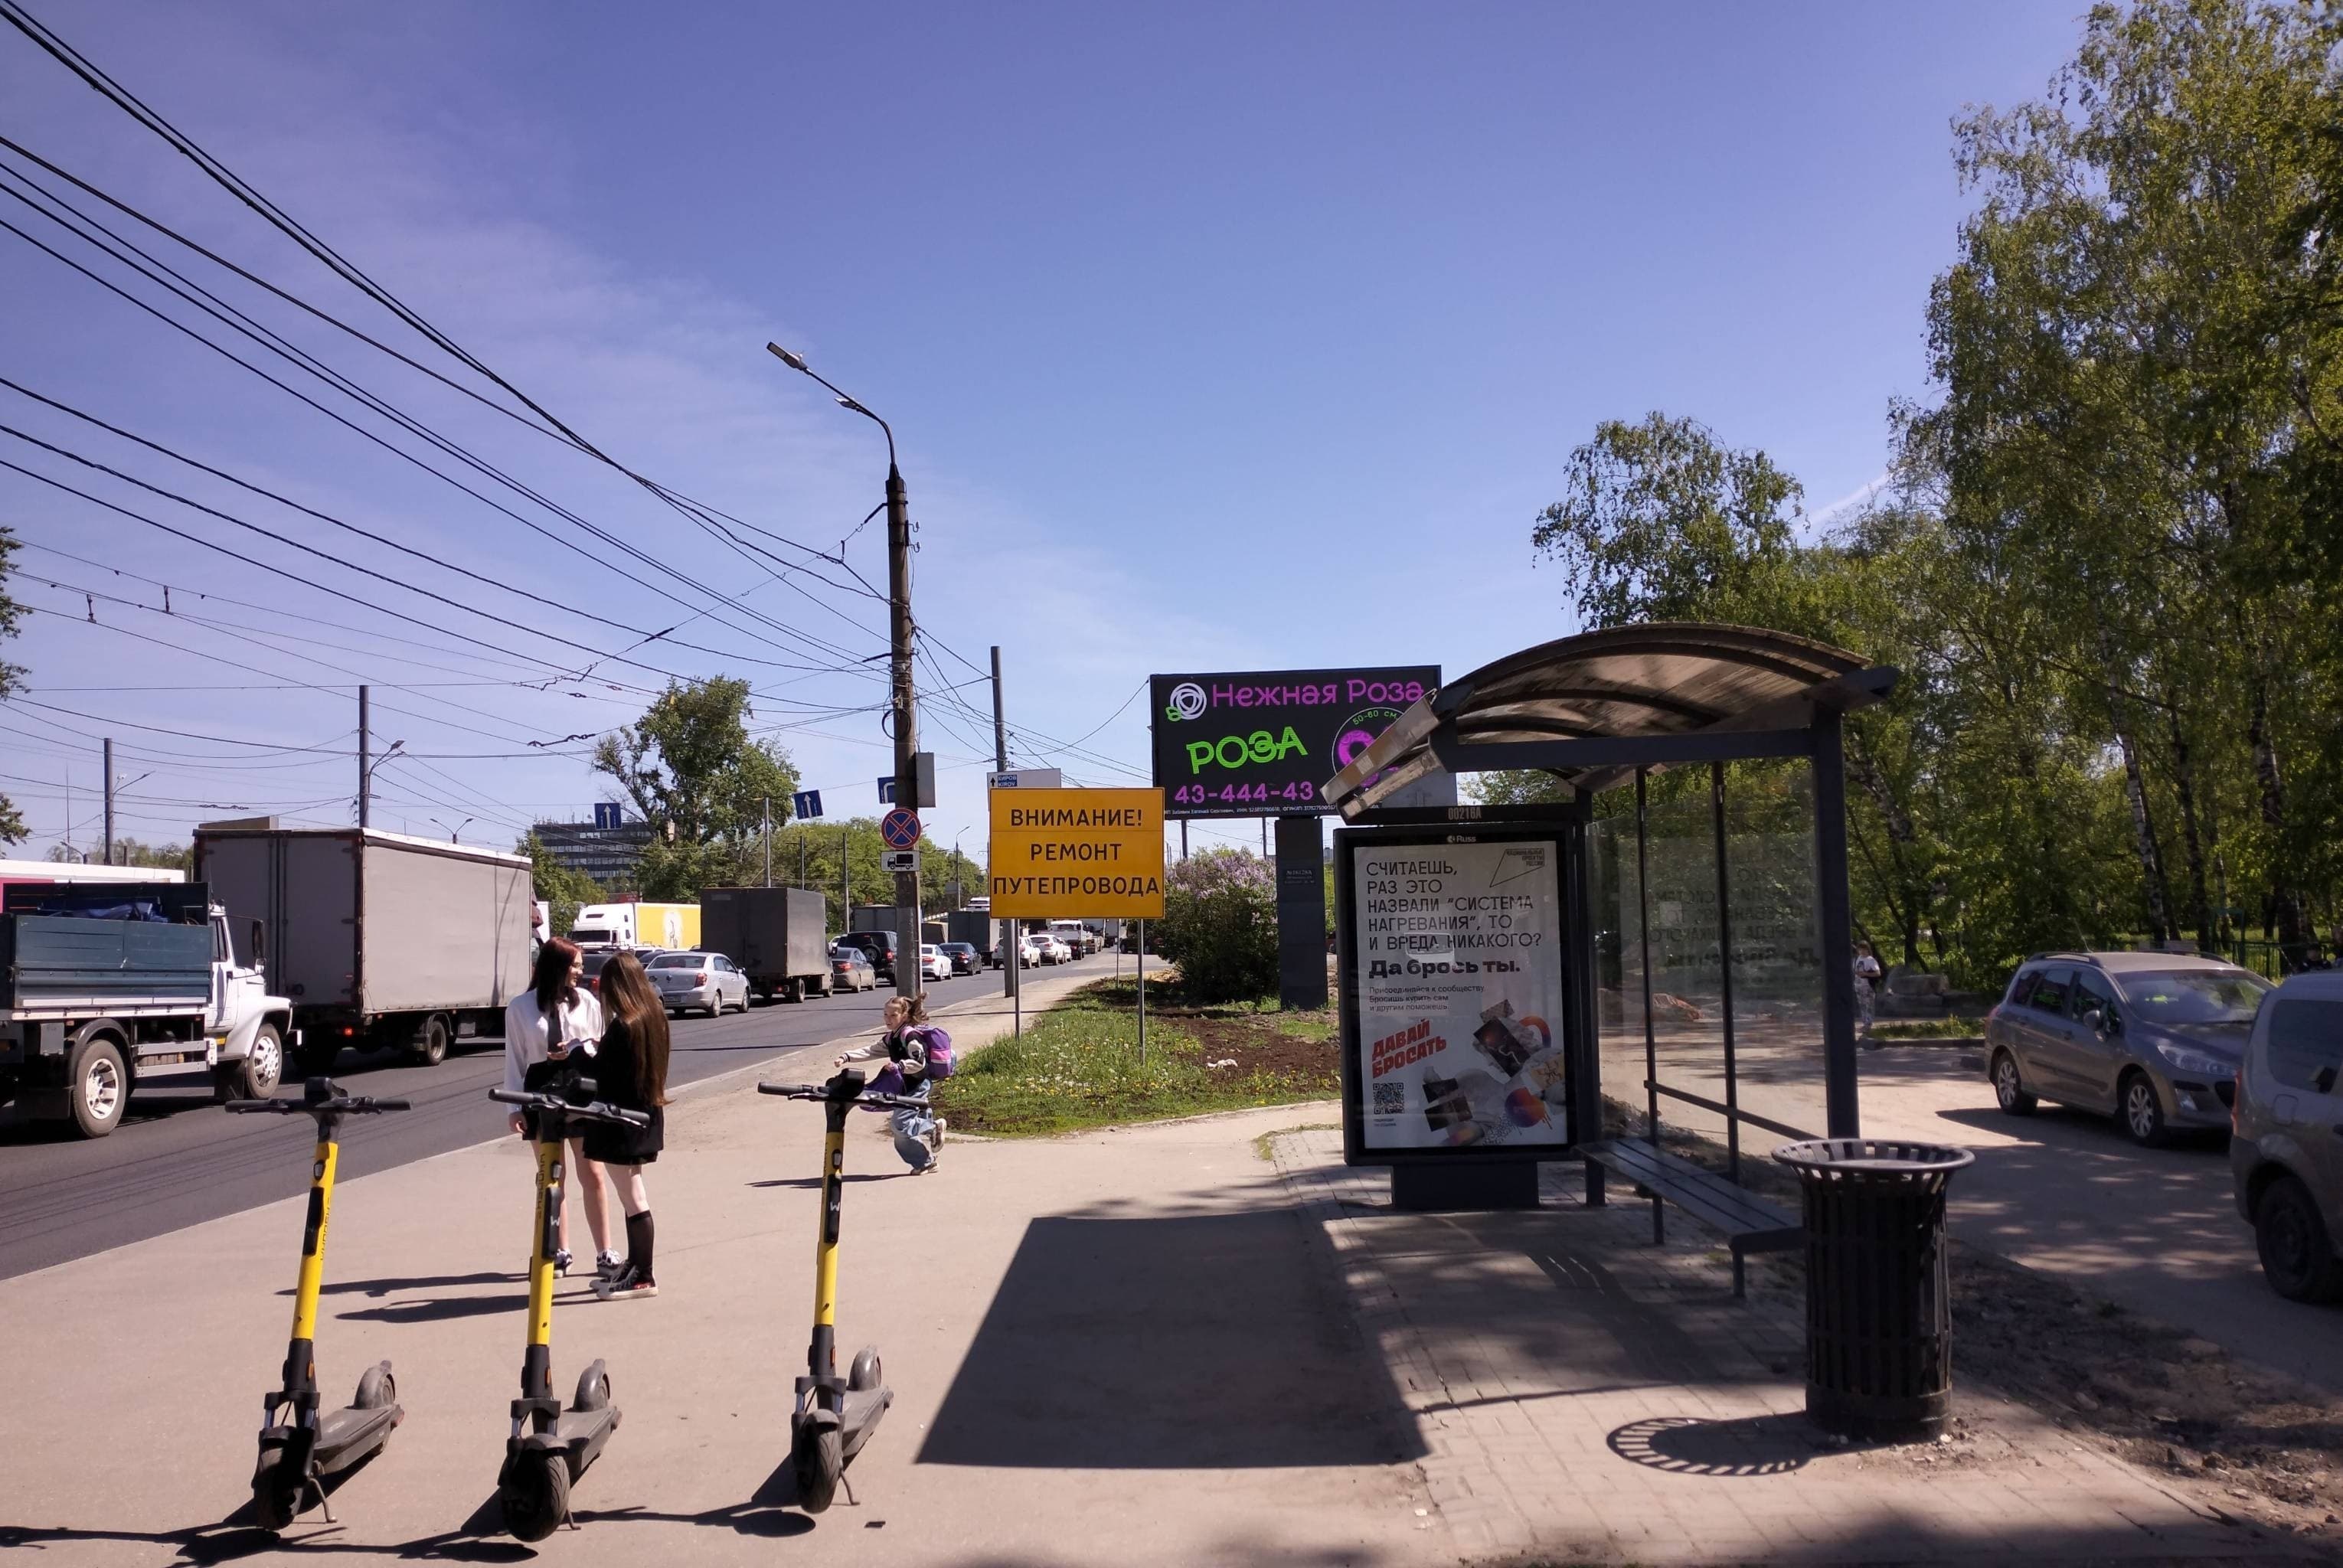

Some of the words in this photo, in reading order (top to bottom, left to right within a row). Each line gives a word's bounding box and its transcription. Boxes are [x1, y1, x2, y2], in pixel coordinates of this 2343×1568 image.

[1213, 684, 1338, 707] Нежная
[1347, 679, 1424, 704] Роза
[1352, 710, 1379, 725] 50-60
[1187, 727, 1309, 775] РОЗА
[1175, 782, 1314, 803] 43-444-43
[1011, 808, 1142, 827] ВНИМАНИЕ!
[1031, 843, 1122, 861] РЕМОНТ
[1366, 861, 1458, 876] СЧИТАЕШЬ,
[993, 877, 1159, 897] ПУТЕПРОВОДА
[1368, 880, 1397, 894] РАЗ
[1406, 880, 1443, 893] ЭТО
[1368, 898, 1439, 913] НАЗВАЛИ
[1489, 915, 1513, 929] ТО
[1369, 936, 1377, 950] И
[1387, 936, 1439, 952] ВРЕДА
[1448, 933, 1542, 949] НИКАКОГО?
[1369, 960, 1403, 979] Да
[1407, 959, 1479, 978] брось
[1482, 960, 1521, 973] ты.
[1372, 1018, 1430, 1061] ДАВАЙ
[1372, 1036, 1446, 1079] БРОСАТЬ
[829, 1201, 841, 1211] W
[550, 1216, 560, 1227] W
